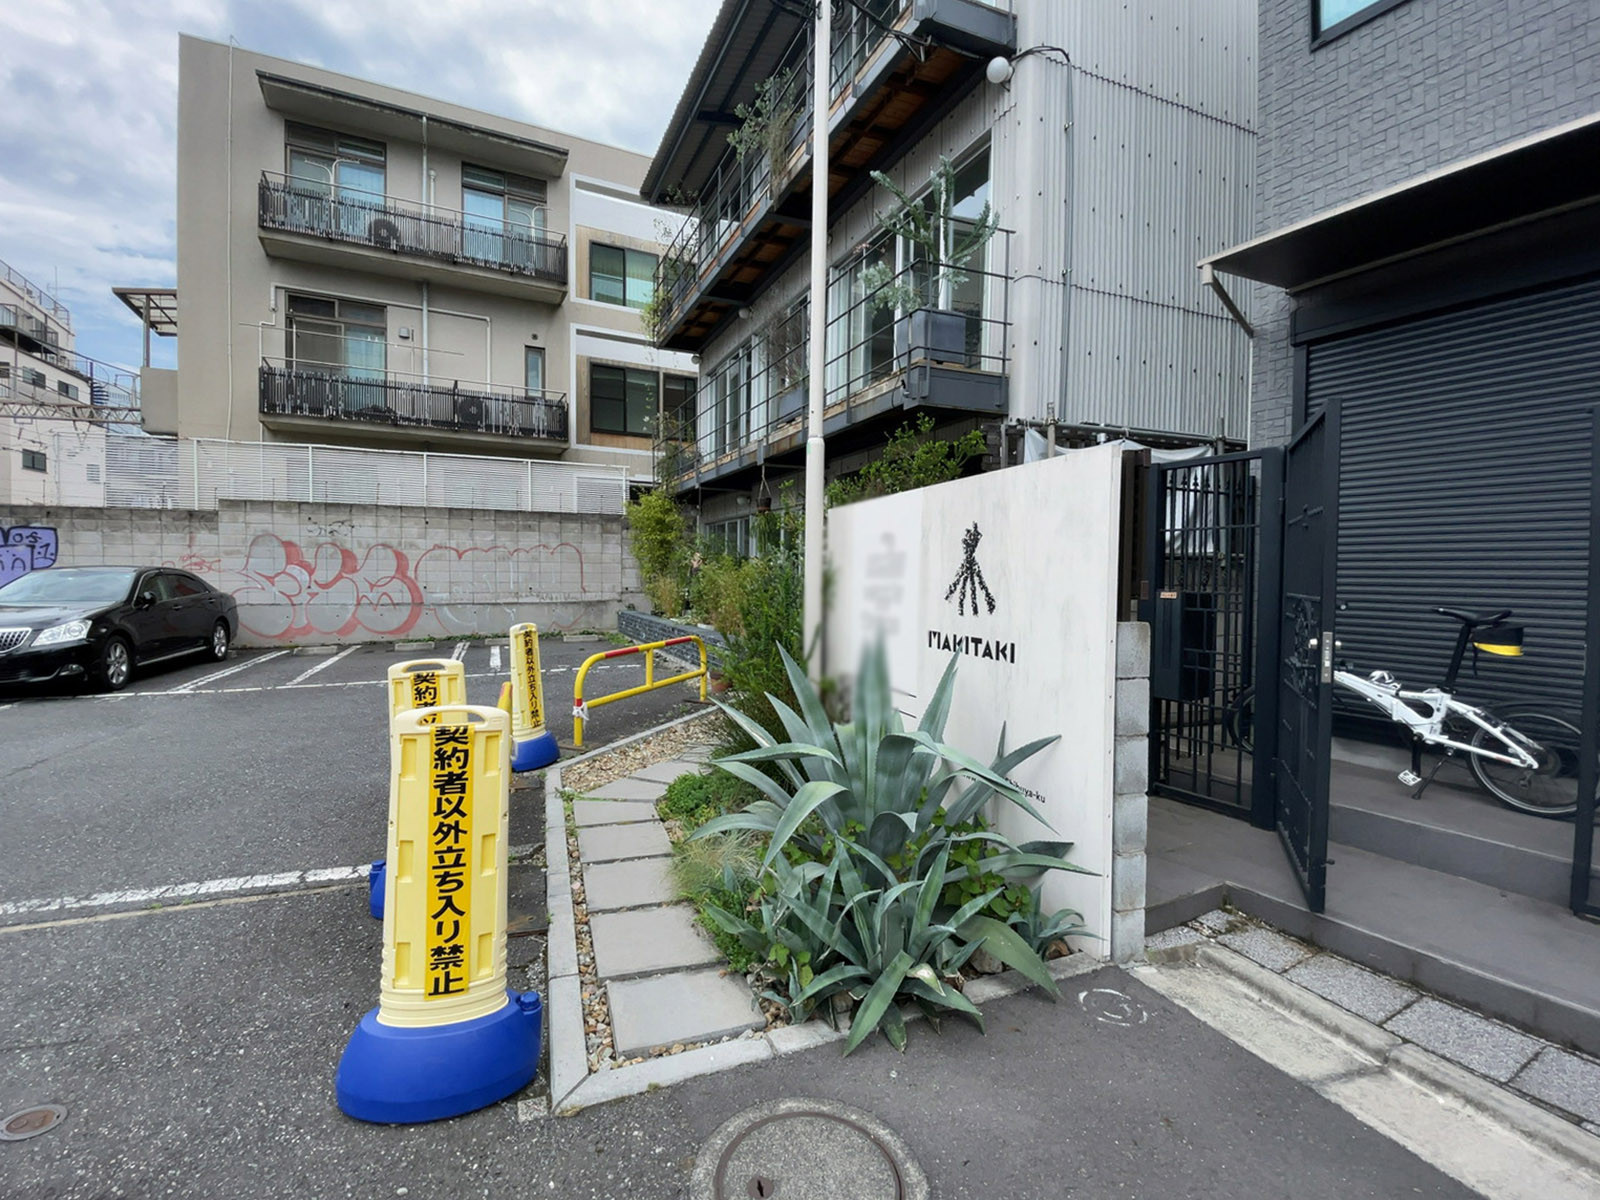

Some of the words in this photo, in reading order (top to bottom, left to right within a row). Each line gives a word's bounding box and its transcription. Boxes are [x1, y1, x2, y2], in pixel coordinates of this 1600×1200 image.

[523, 630, 541, 729] 契約者以外立ち入り禁止
[928, 630, 1015, 664] MAKITAKI
[428, 725, 470, 997] 契約者以外立ち入り禁止
